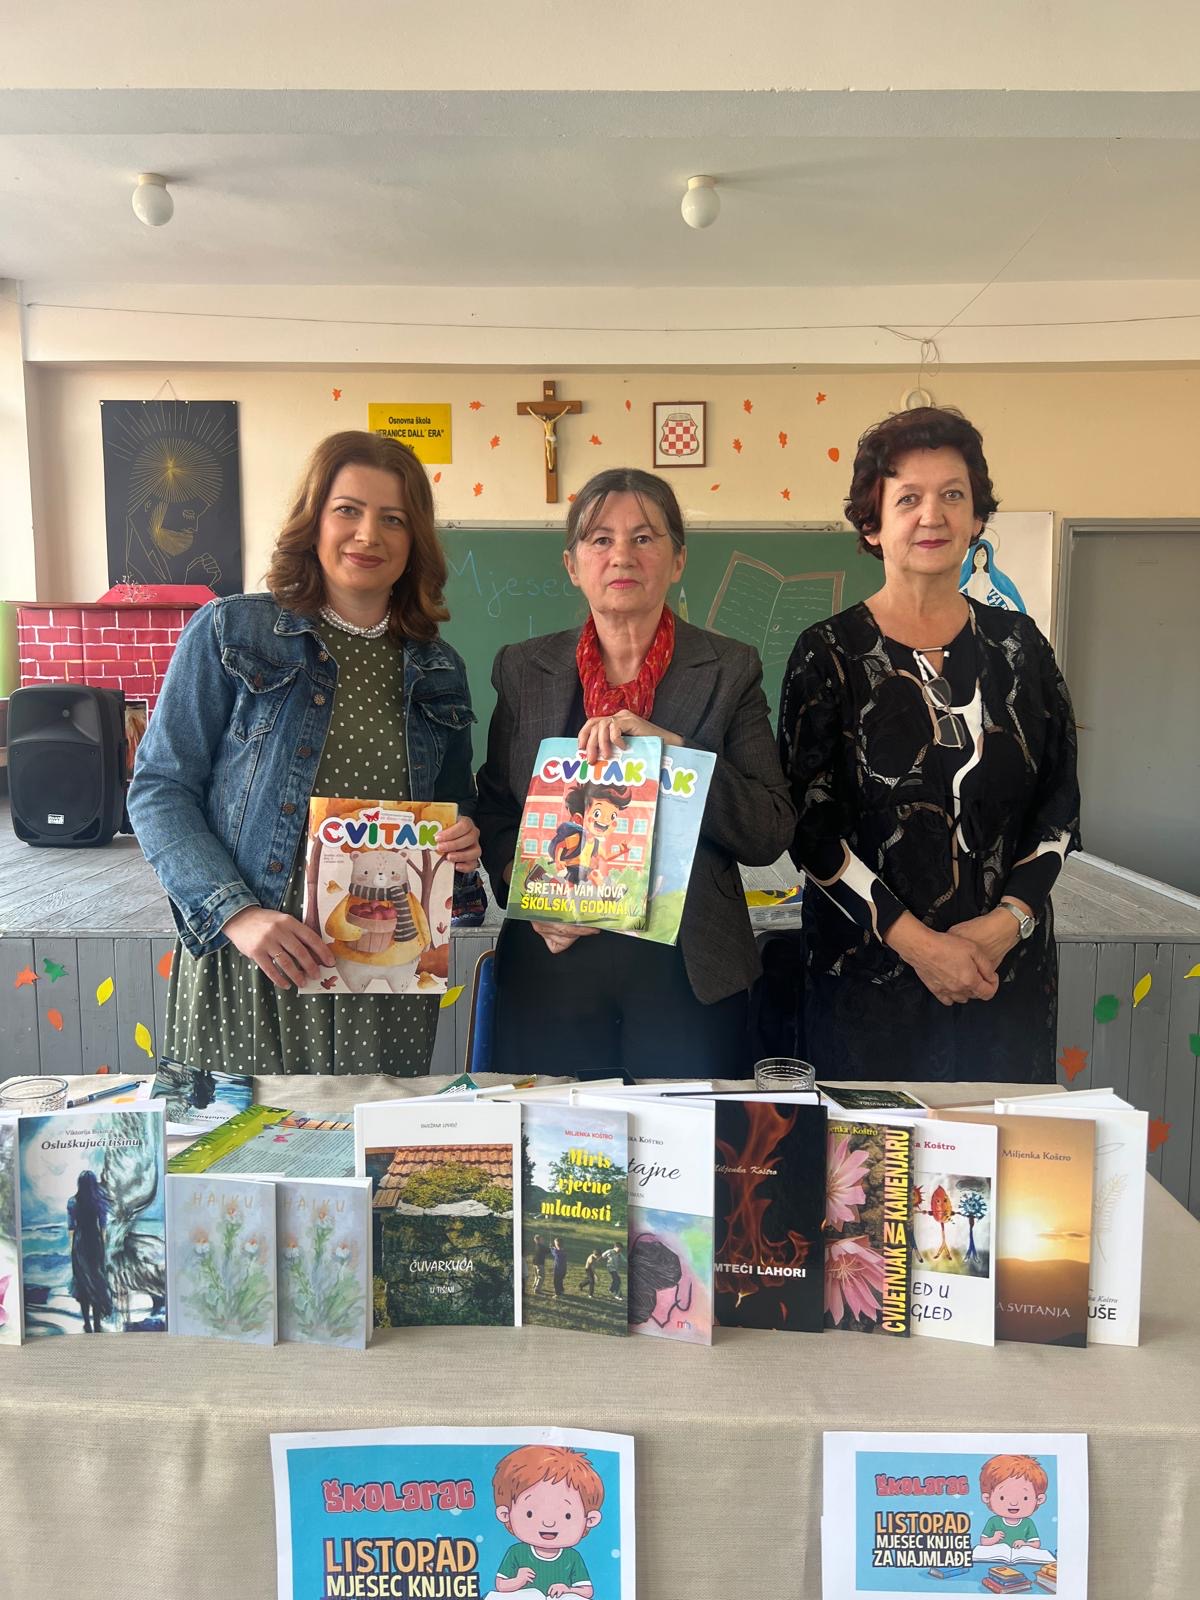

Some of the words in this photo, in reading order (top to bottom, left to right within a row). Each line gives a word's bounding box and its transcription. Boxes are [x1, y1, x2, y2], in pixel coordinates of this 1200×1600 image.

[388, 416, 414, 425] Osnovna
[415, 416, 431, 425] škola
[543, 759, 645, 783] CVITAK
[322, 820, 438, 847] CVITAK
[526, 882, 571, 897] SRETNA
[574, 885, 594, 897] VAM
[597, 883, 628, 898] NOVA
[520, 893, 577, 912] ŠKOLSKA
[41, 1138, 106, 1150] Osluškujući
[924, 1141, 956, 1151] Koštro
[568, 1147, 612, 1169] Miris
[1001, 1149, 1041, 1160] Miljenka
[1043, 1152, 1072, 1162] Koštro
[883, 1129, 910, 1221] KAMENJARU
[558, 1175, 612, 1196] vječne
[541, 1199, 612, 1222] mladosti
[883, 1222, 907, 1245] NA
[409, 1257, 474, 1273] ČUVARKUĆA
[757, 1266, 806, 1279] LAHORI
[882, 1247, 907, 1333] CVIJETNJAK
[939, 1284, 950, 1299] U
[1007, 1302, 1071, 1318] SVITANJA
[876, 1512, 971, 1535] LISTOPAD
[876, 1534, 924, 1549] MJESEC
[926, 1535, 971, 1550] KNJIGE
[324, 1538, 478, 1574] LISTOPAD
[873, 1550, 894, 1567] ZA
[896, 1550, 973, 1568] NAJMLAĐE
[326, 1574, 403, 1597] MJESEC
[408, 1574, 479, 1598] KNJIGE
